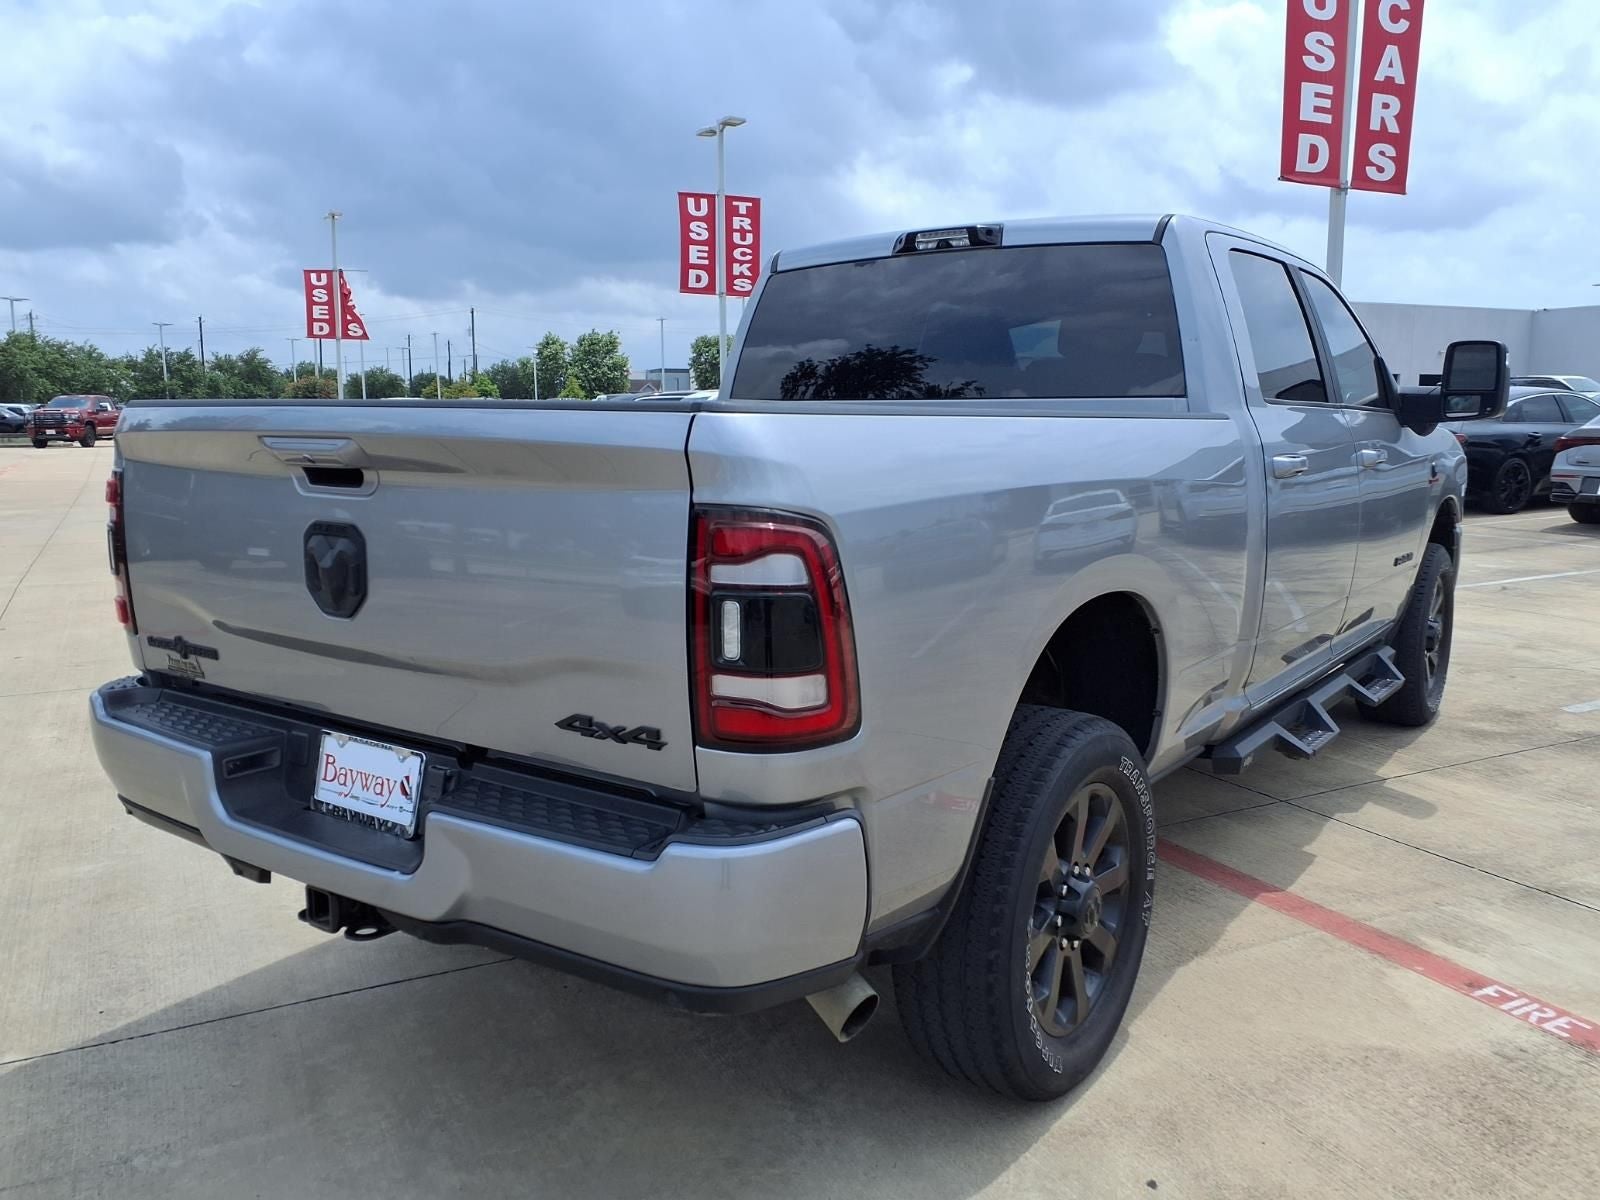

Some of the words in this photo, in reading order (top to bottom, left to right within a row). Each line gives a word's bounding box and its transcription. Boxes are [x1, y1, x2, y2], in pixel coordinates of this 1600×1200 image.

[1365, 0, 1411, 182] CARS
[687, 197, 709, 289] USED
[732, 201, 754, 292] TRUCKS
[310, 272, 330, 336] USED
[321, 753, 398, 808] Bayway
[1470, 984, 1593, 1038] FIRE
